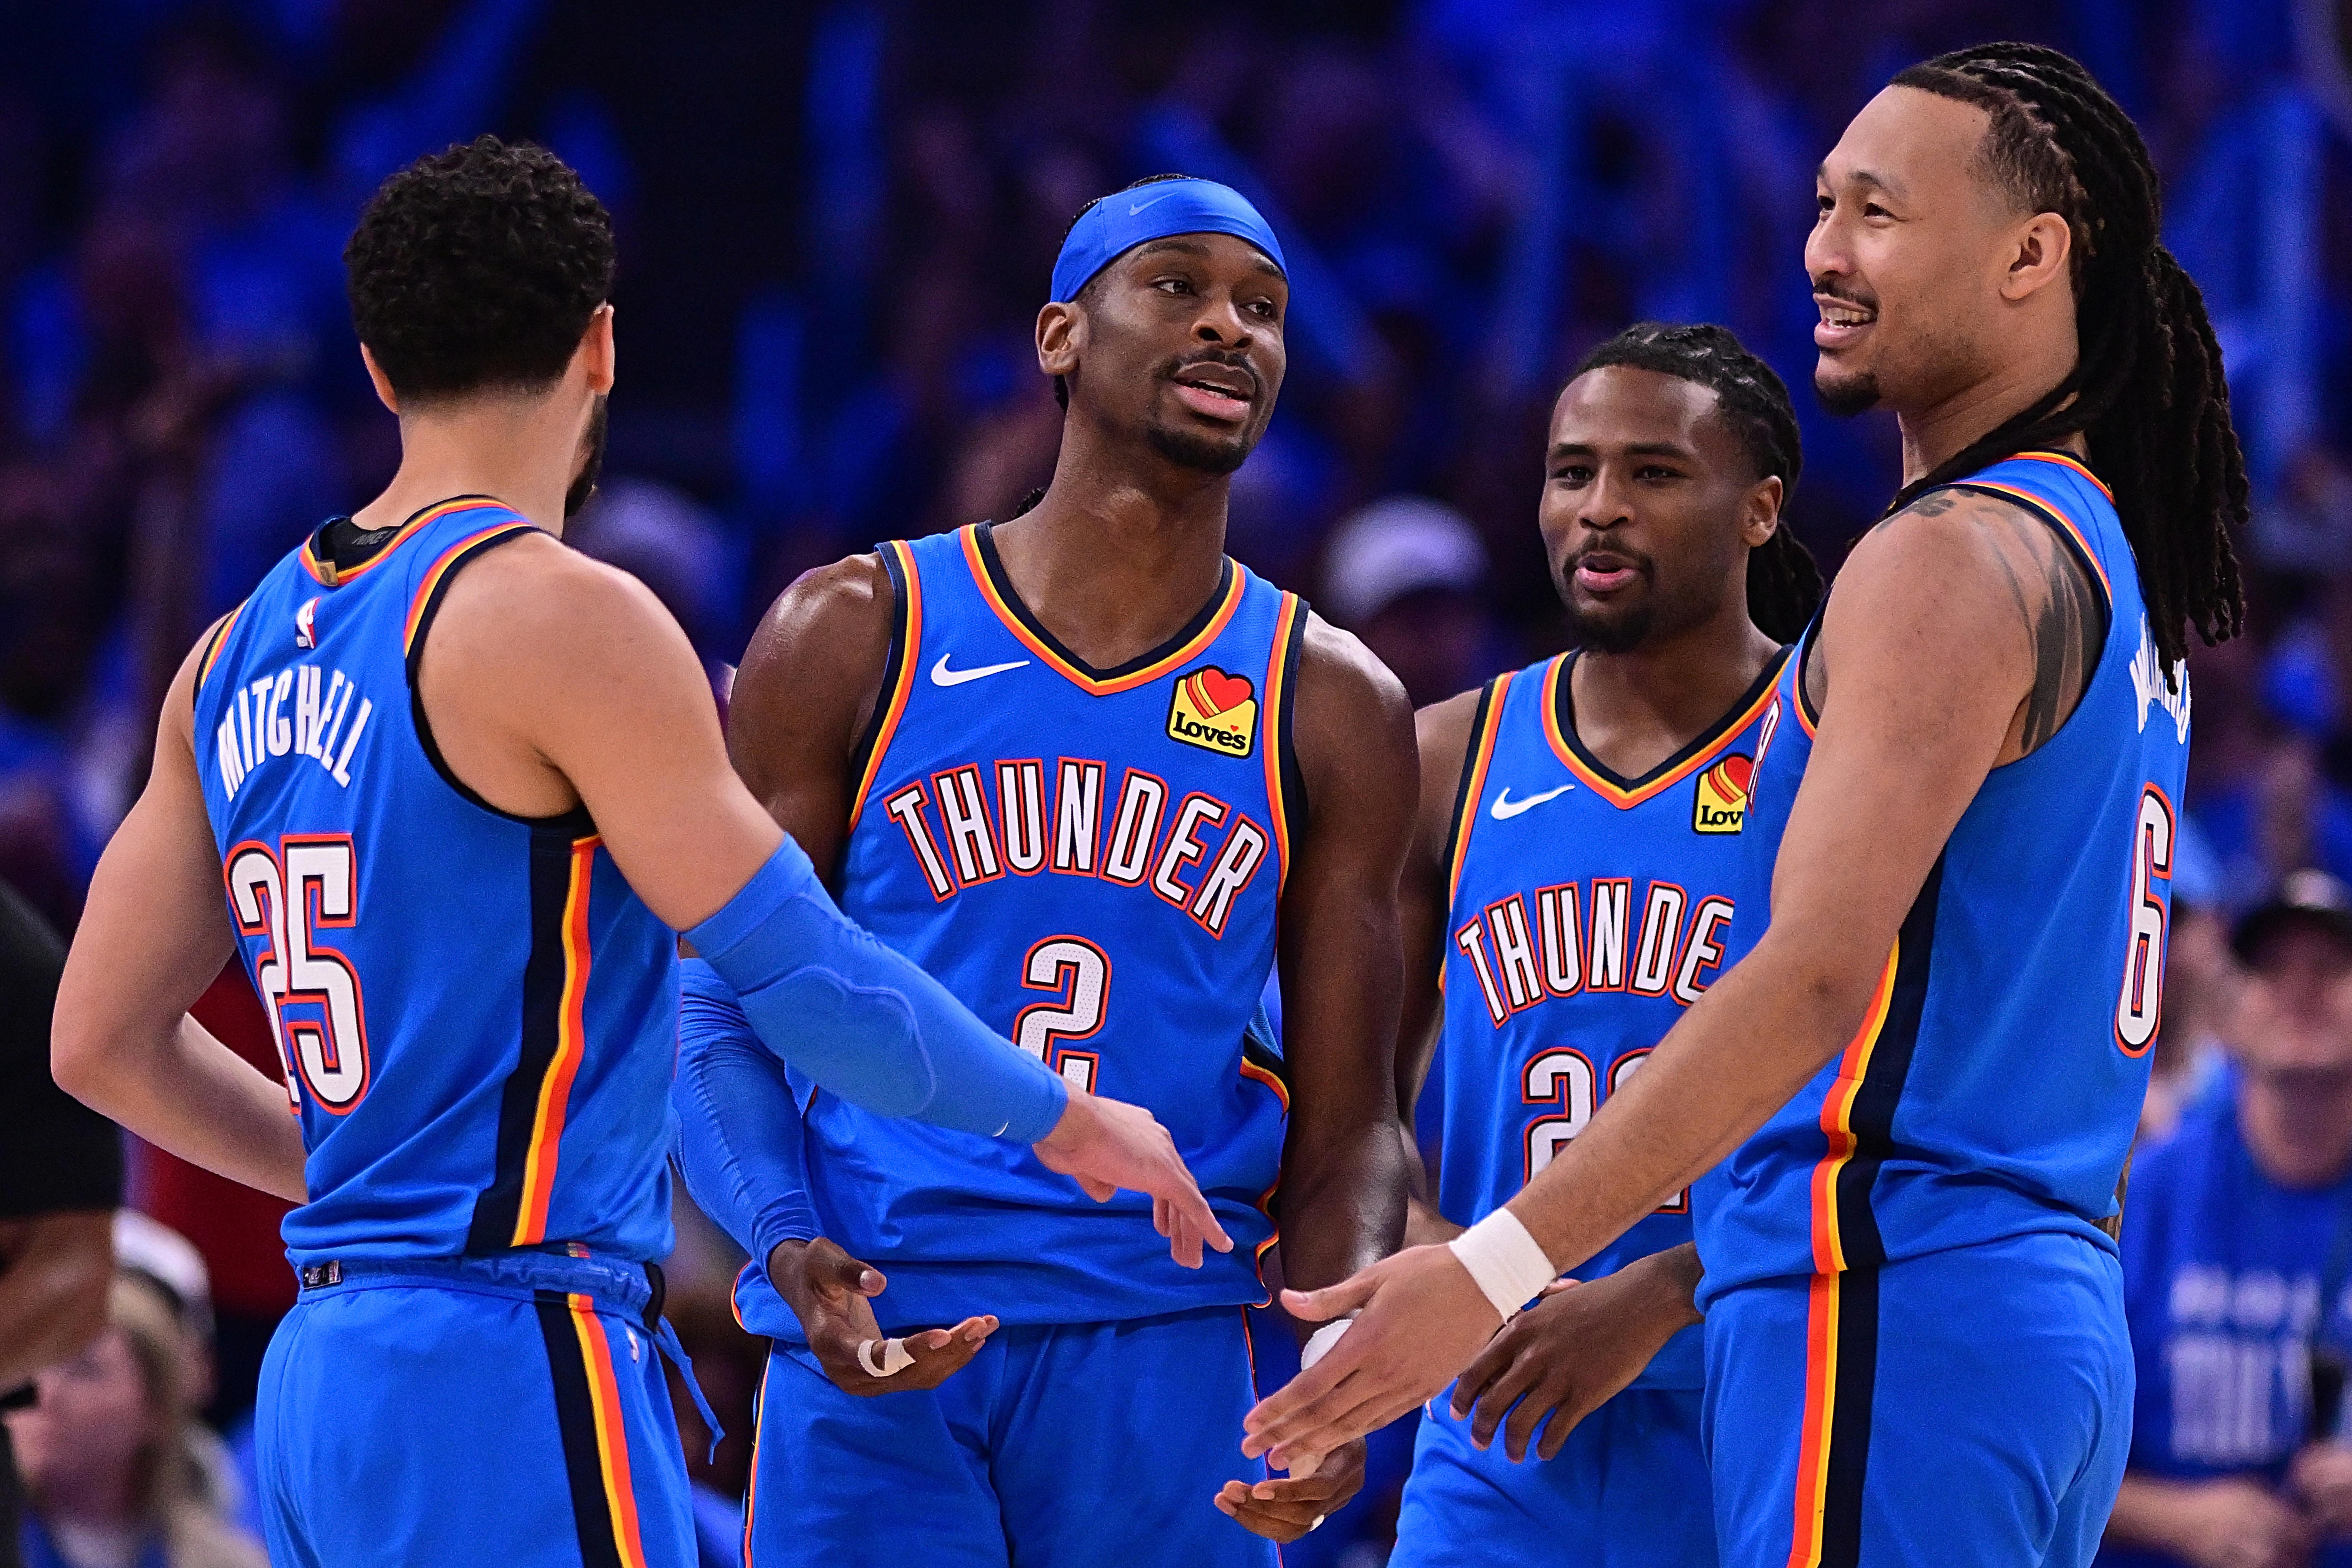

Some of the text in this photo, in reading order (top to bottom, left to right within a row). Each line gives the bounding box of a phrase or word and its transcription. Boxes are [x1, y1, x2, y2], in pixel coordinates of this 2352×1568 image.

[218, 665, 372, 803] MITCHELL
[1173, 711, 1247, 750] Loves
[884, 756, 1269, 940] THUNDER
[1700, 805, 1744, 825] Lov
[224, 833, 370, 1116] 25
[1455, 877, 1735, 1029] THUNDE
[2115, 781, 2176, 1058] 6
[1011, 934, 1112, 1094] 2
[1521, 1046, 1689, 1215] 2
